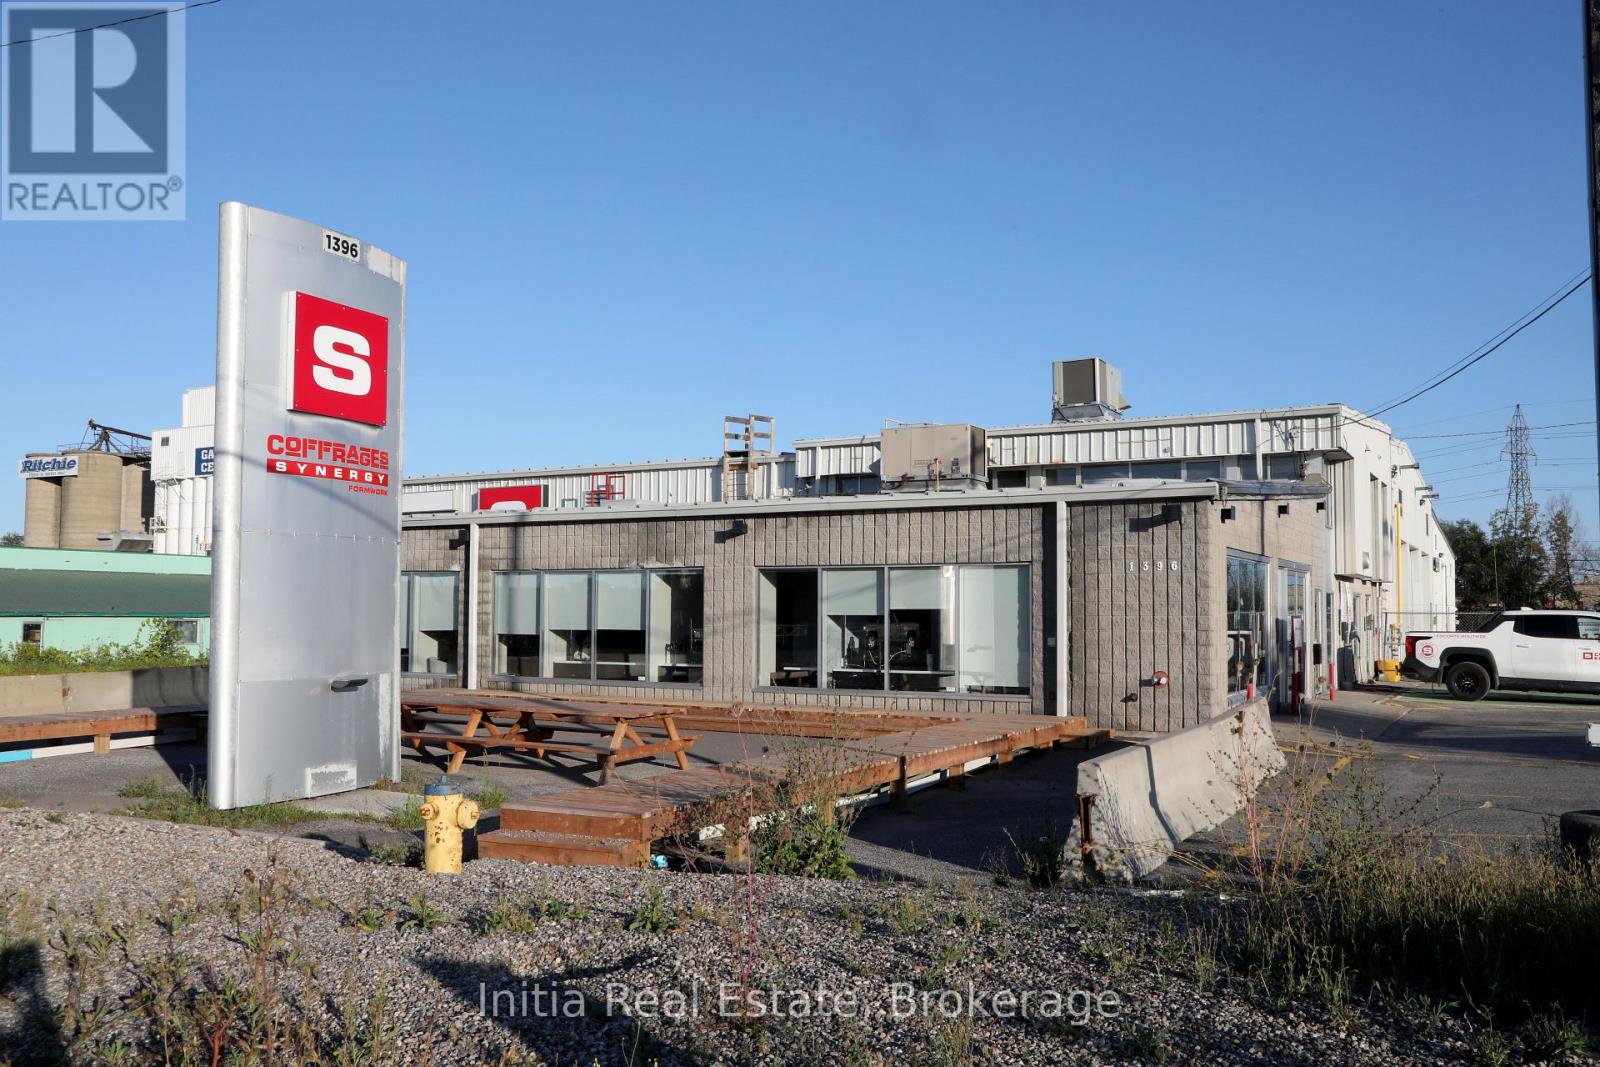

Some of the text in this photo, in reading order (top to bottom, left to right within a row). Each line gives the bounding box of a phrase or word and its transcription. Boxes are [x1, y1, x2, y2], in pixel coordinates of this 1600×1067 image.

[325, 234, 358, 258] 1396
[312, 325, 371, 396] S
[267, 434, 389, 470] COFFRAGES
[20, 457, 77, 473] Ritchie
[275, 461, 385, 484] SYNERGY
[348, 485, 388, 496] FORMWORK
